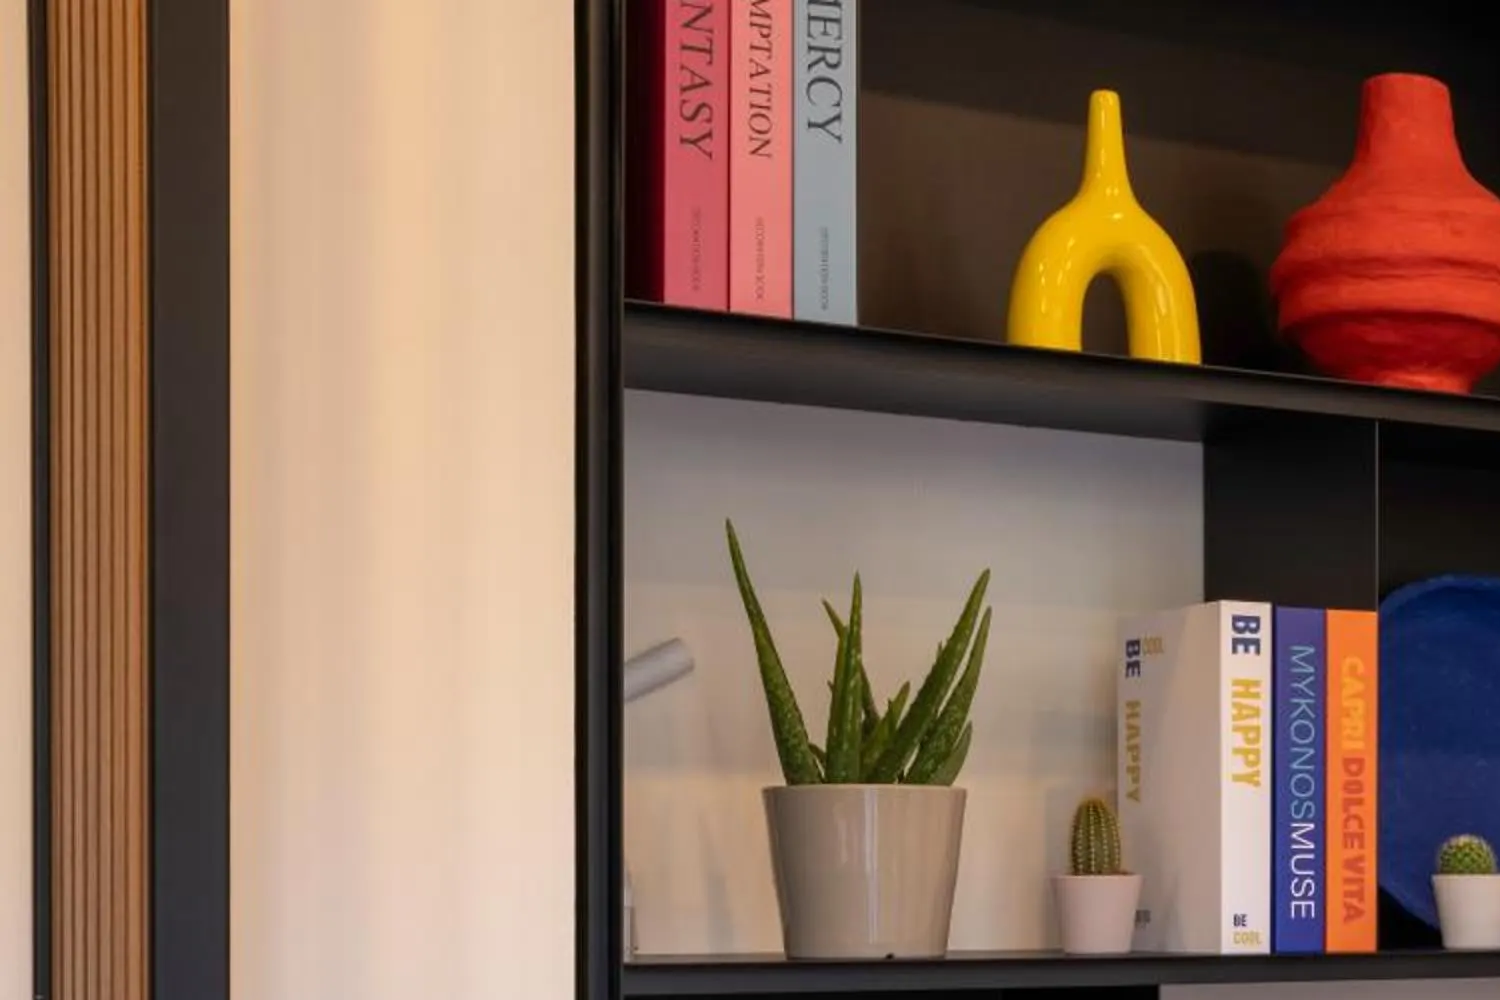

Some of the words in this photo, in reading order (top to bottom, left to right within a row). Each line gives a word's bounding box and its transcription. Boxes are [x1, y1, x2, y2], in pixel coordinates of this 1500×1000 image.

[1125, 638, 1140, 677] BE
[1231, 614, 1260, 655] BE
[1231, 678, 1262, 787] HAPPY
[1341, 656, 1365, 750] CAPRI
[1125, 700, 1141, 802] HAPPY
[1342, 756, 1365, 849] DOLCE
[1232, 913, 1247, 927] BE
[1342, 854, 1365, 924] VITA
